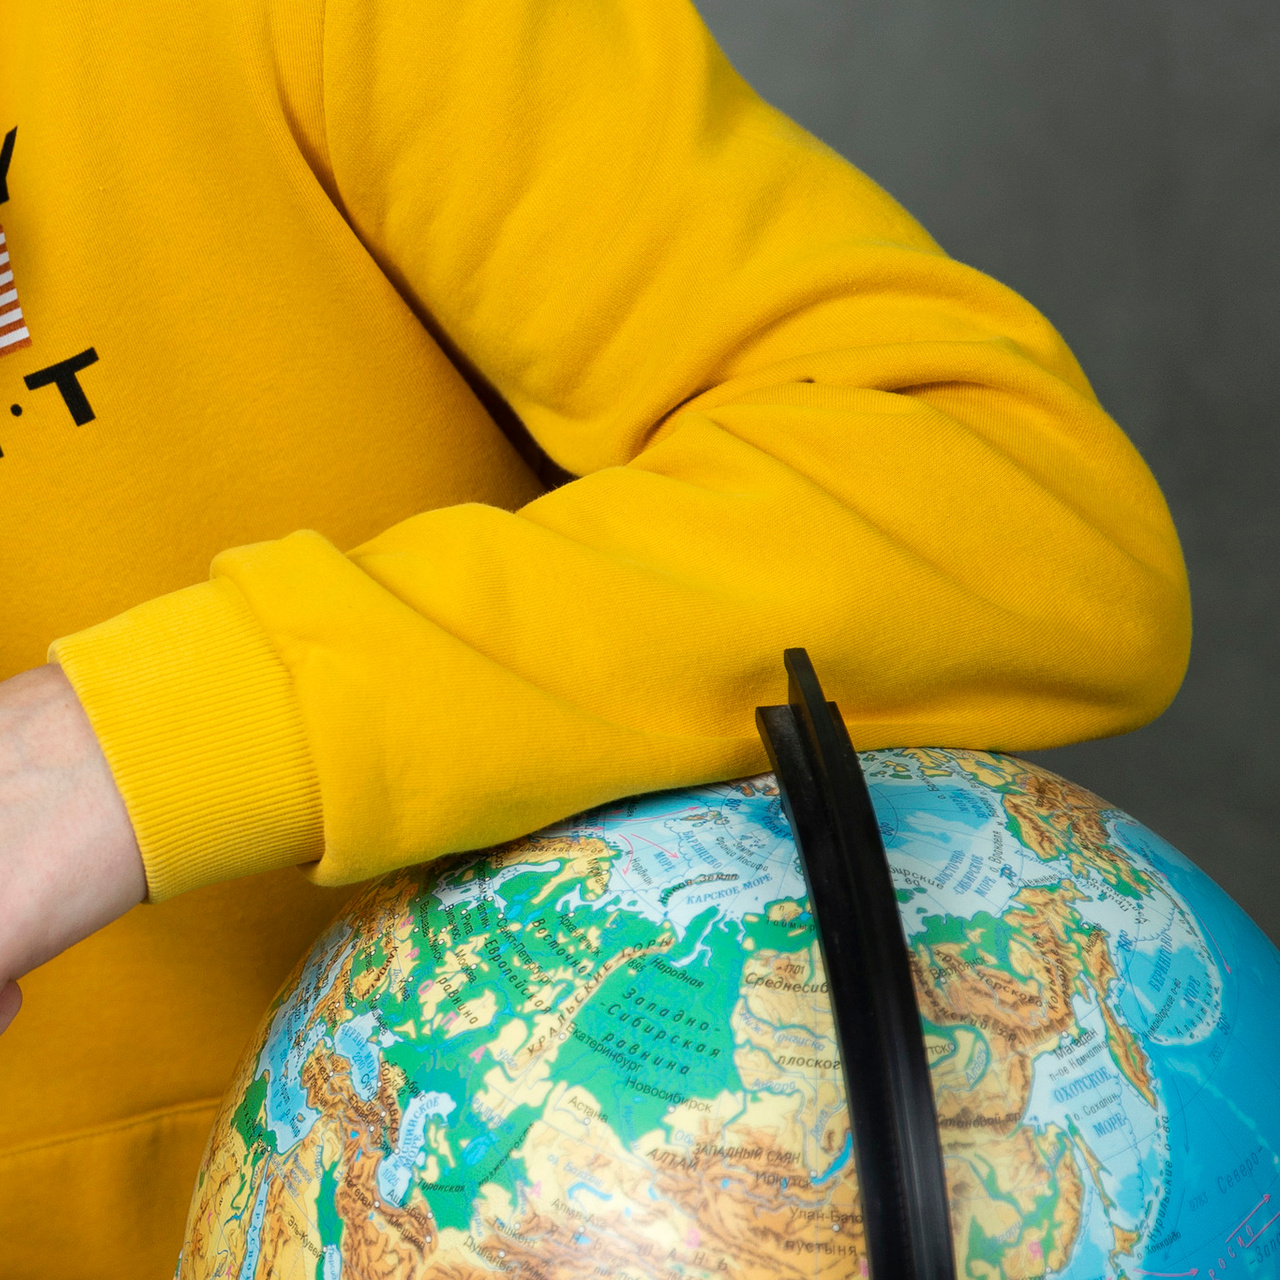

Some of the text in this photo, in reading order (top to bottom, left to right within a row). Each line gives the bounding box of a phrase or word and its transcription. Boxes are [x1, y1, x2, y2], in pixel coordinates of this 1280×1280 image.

[686, 873, 773, 906] КАРСКОЕ МОРЕ
[975, 873, 998, 899] МОРЕ
[427, 933, 443, 964] Минск
[496, 918, 554, 986] Санкт-Петербург
[558, 911, 603, 957] Архангельск
[454, 948, 478, 984] Москва
[651, 957, 705, 990] Народная
[526, 937, 674, 1057] УРАЛЬСКИЕ ГОРЫ
[568, 1020, 643, 1073] Екатеринбург
[600, 987, 722, 1075] Западно- -Сибирская равнина
[1053, 1028, 1098, 1061] Магадан
[396, 1068, 427, 1101] Эльбрус
[624, 1076, 713, 1113] Новосибирск
[1053, 1066, 1128, 1138] ОХОТСКОЕ МОРЕ
[568, 1095, 609, 1123] Астана
[1082, 1092, 1120, 1116] Сахалин
[394, 1096, 440, 1171] КАСПИЙСКОЕ
[693, 1142, 764, 1160] ЗАПАДНЫЙ
[755, 1170, 813, 1189] Иркутск
[1216, 1146, 1264, 1195] Северо-
[1147, 1160, 1174, 1243] Курильские
